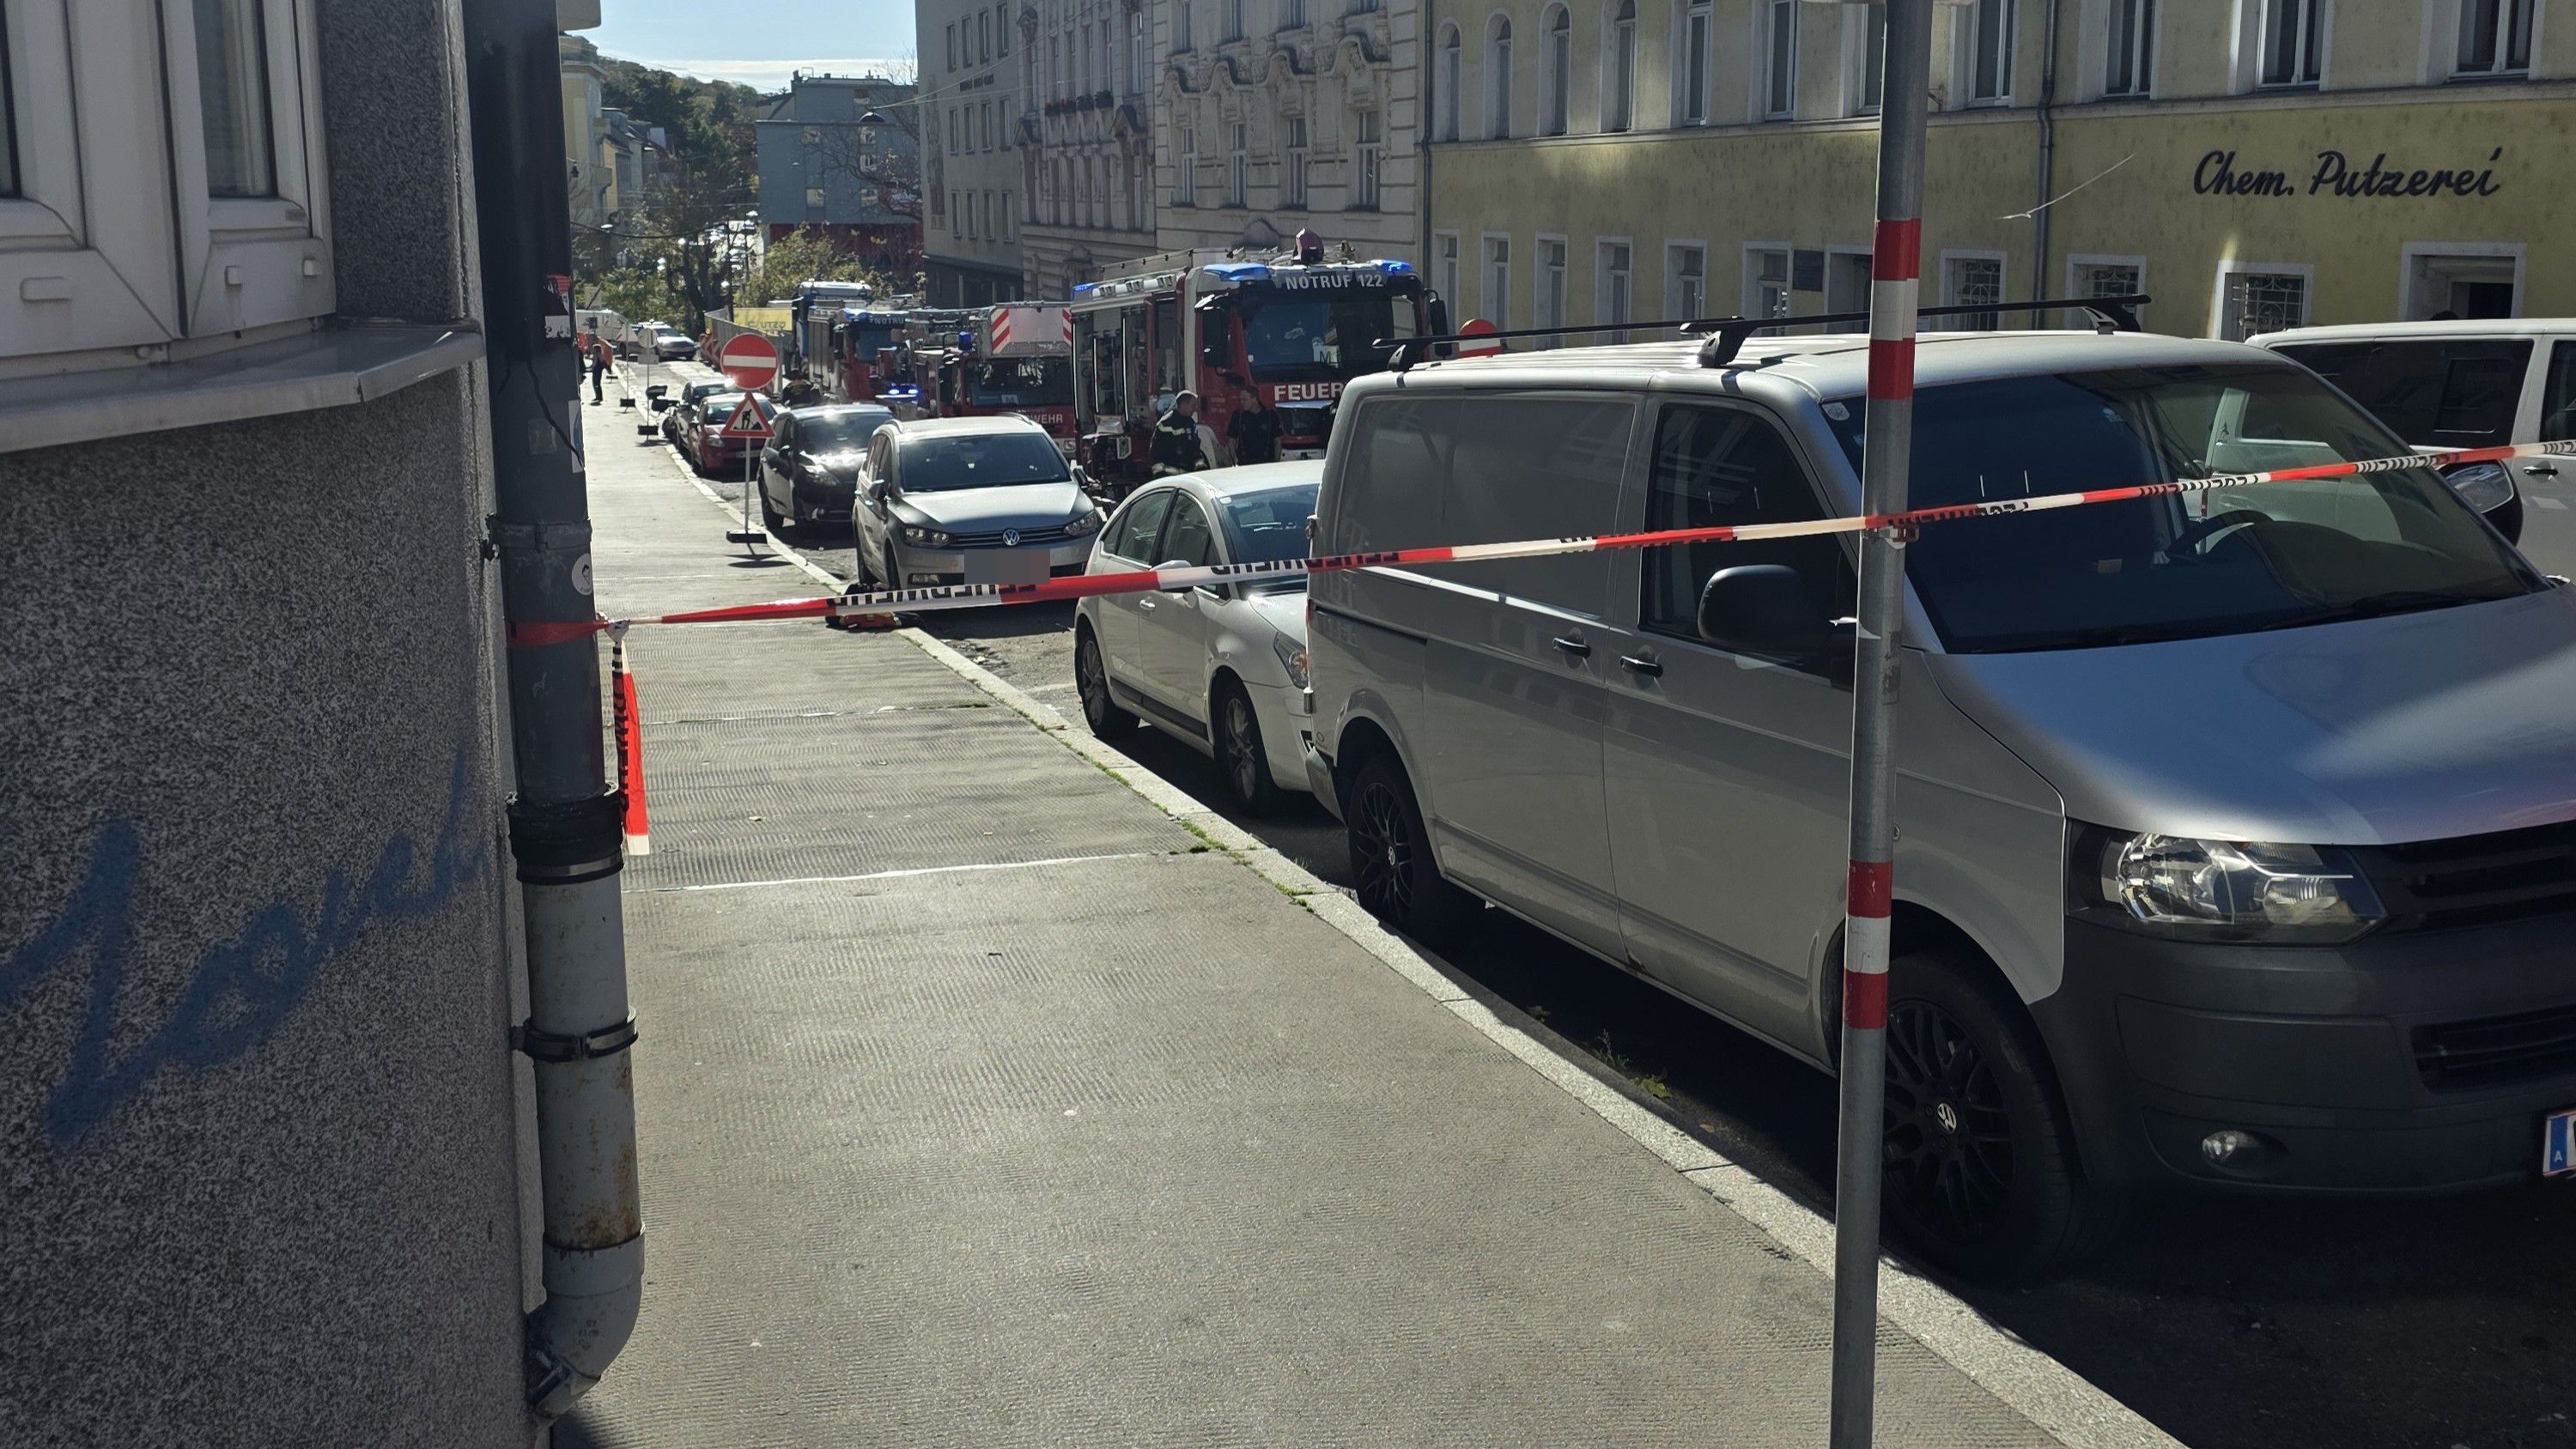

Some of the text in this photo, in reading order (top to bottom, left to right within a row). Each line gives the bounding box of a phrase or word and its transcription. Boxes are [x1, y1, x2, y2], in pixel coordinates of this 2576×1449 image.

[2193, 146, 2502, 197] Chem. Putzerei
[1285, 273, 1384, 290] NOTRUF 122
[874, 317, 904, 325] NOTRU
[1029, 414, 1063, 424] WEHR
